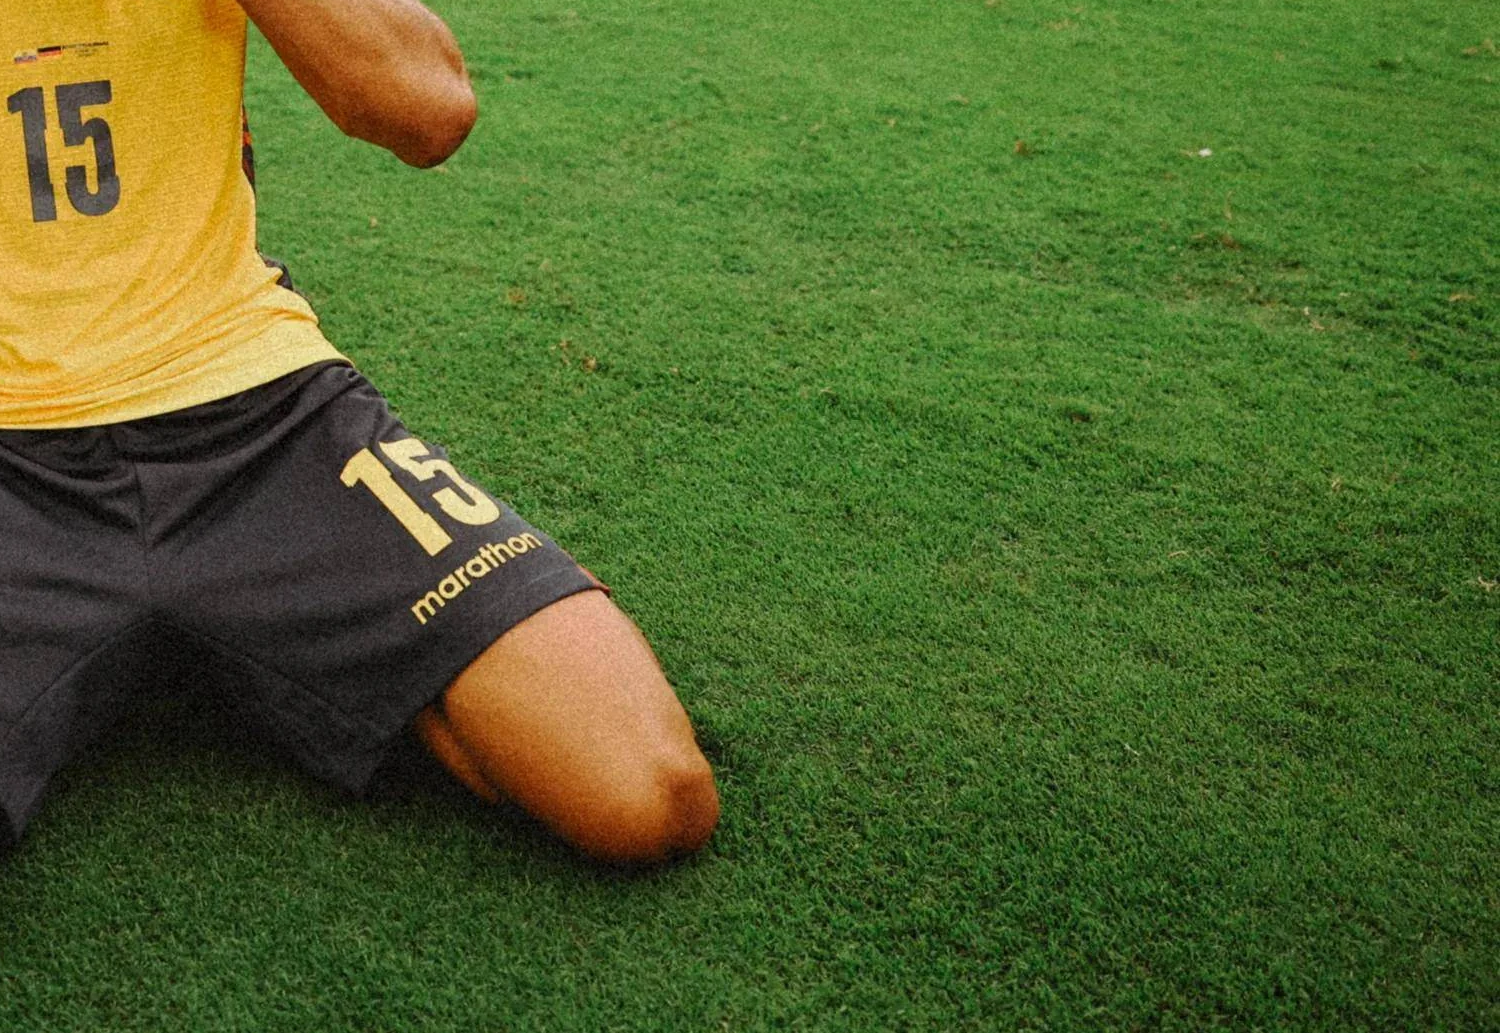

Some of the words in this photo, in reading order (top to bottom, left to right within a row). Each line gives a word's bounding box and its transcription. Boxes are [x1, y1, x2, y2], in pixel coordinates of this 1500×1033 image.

[7, 79, 121, 223] 15
[340, 437, 501, 557] 15
[411, 532, 543, 624] marathon
